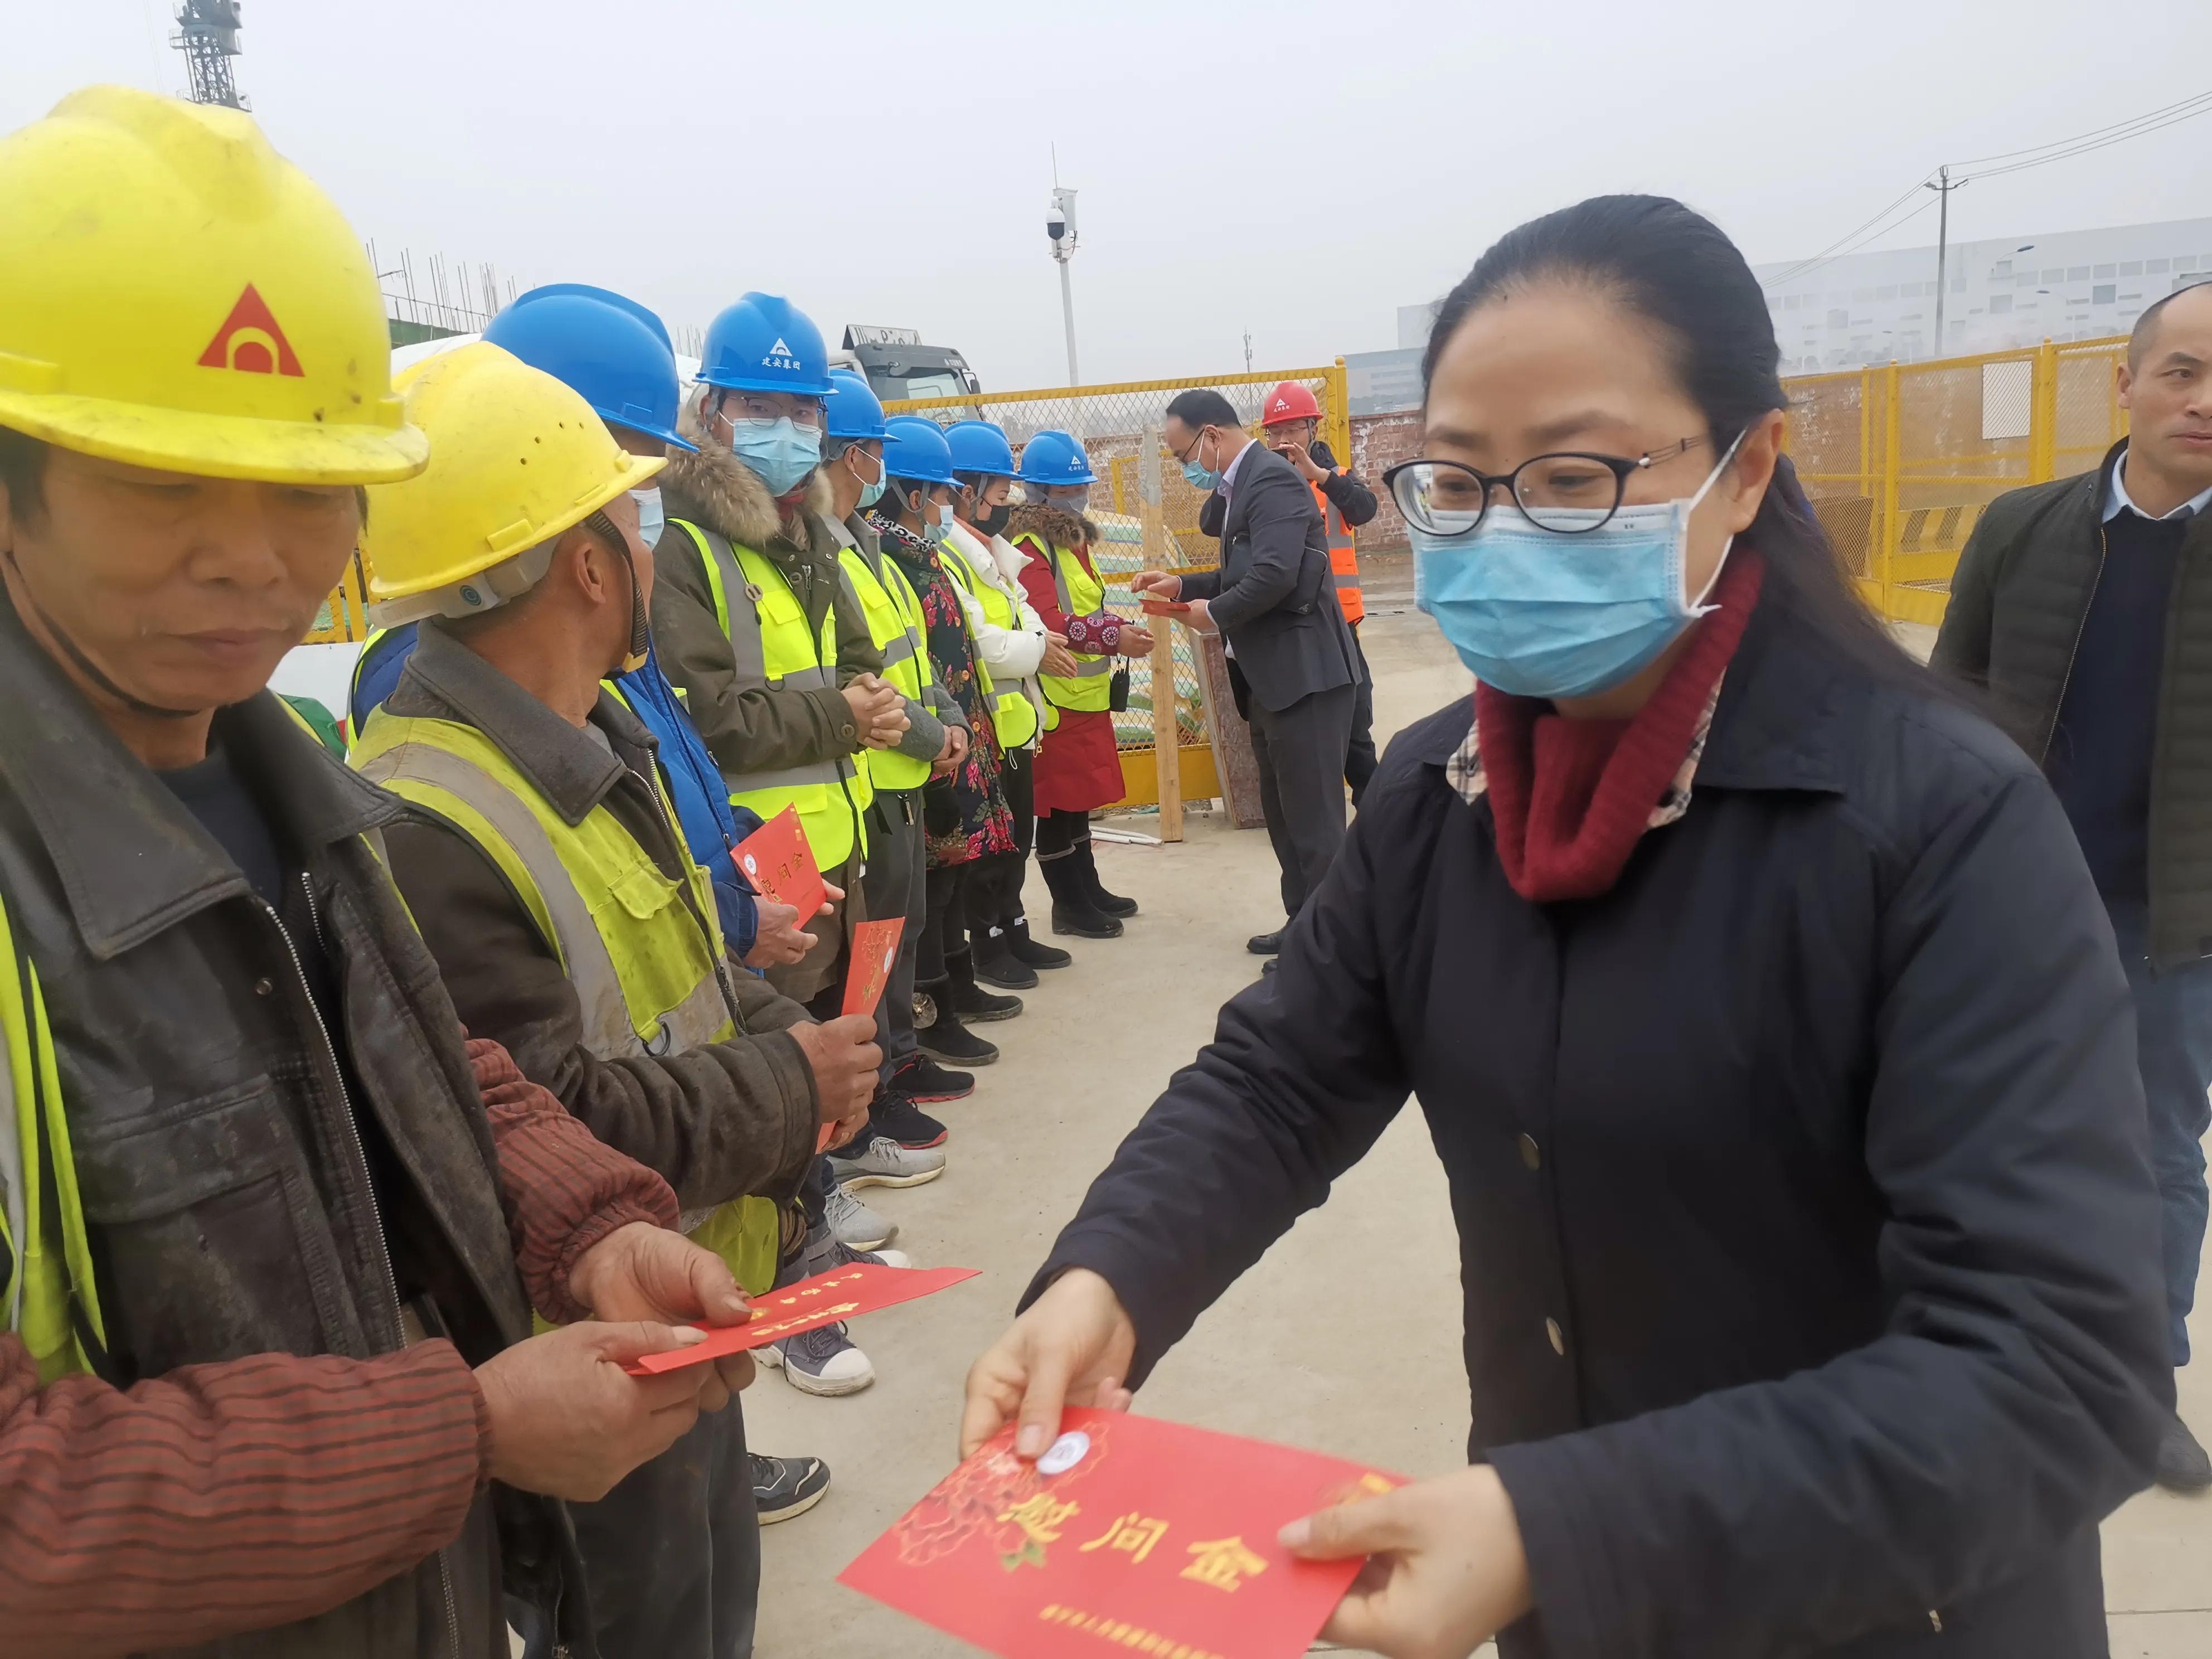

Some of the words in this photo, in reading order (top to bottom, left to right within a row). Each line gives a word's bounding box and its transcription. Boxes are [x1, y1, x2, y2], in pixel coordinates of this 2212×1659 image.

[761, 357, 801, 371] 建安集团
[996, 1492, 1269, 1593] 慰问金
